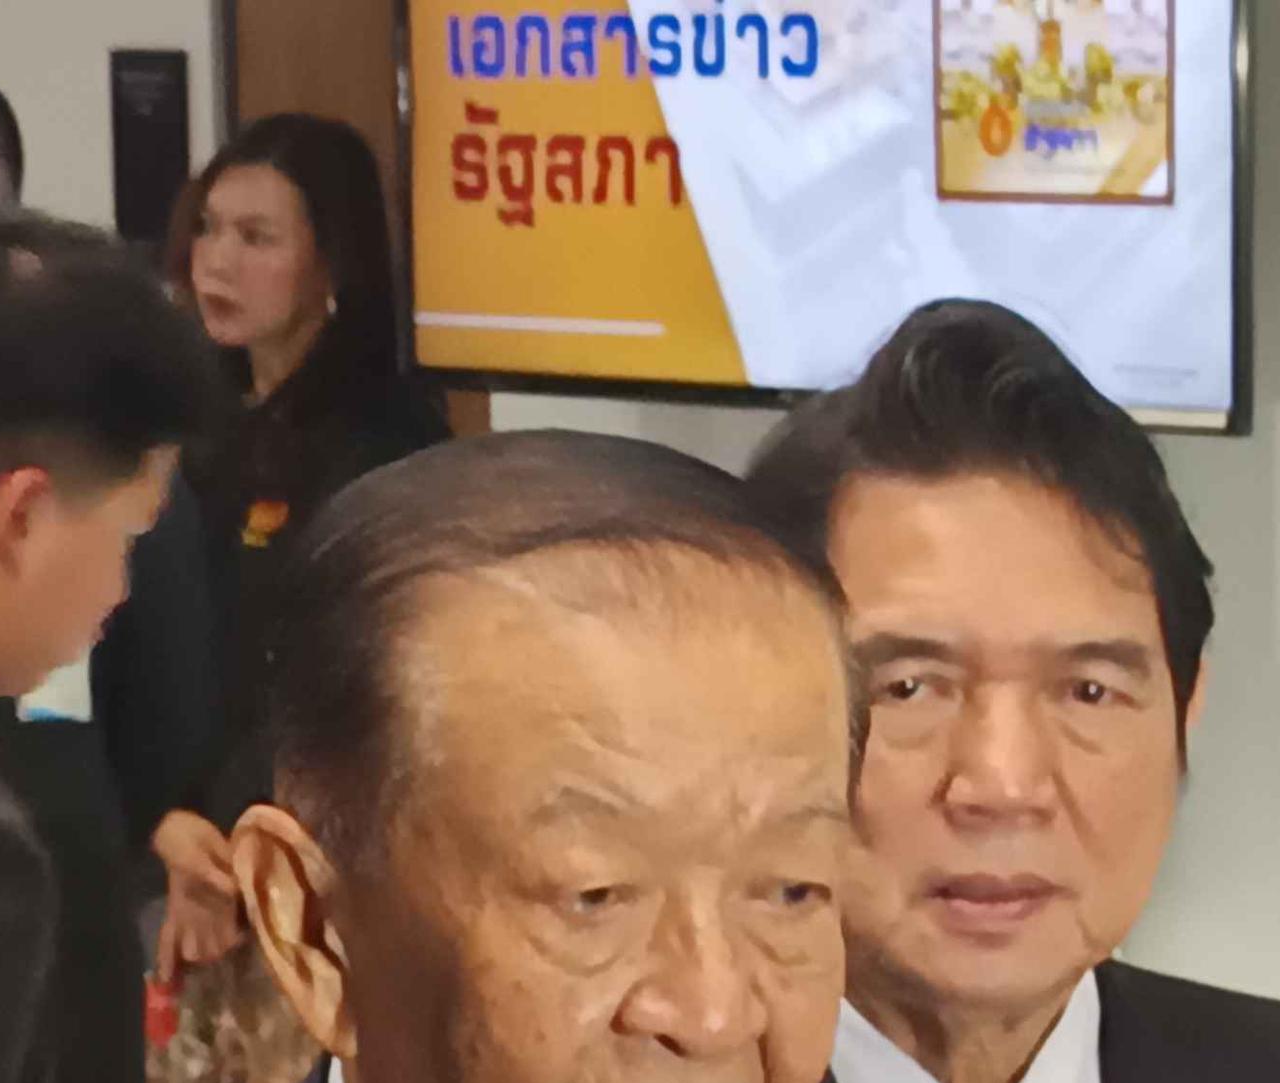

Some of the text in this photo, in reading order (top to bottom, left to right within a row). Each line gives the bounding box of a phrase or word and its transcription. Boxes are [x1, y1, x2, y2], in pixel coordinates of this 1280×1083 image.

[448, 12, 819, 79] เอกสารขาว
[451, 100, 681, 228] รัฐสภา
